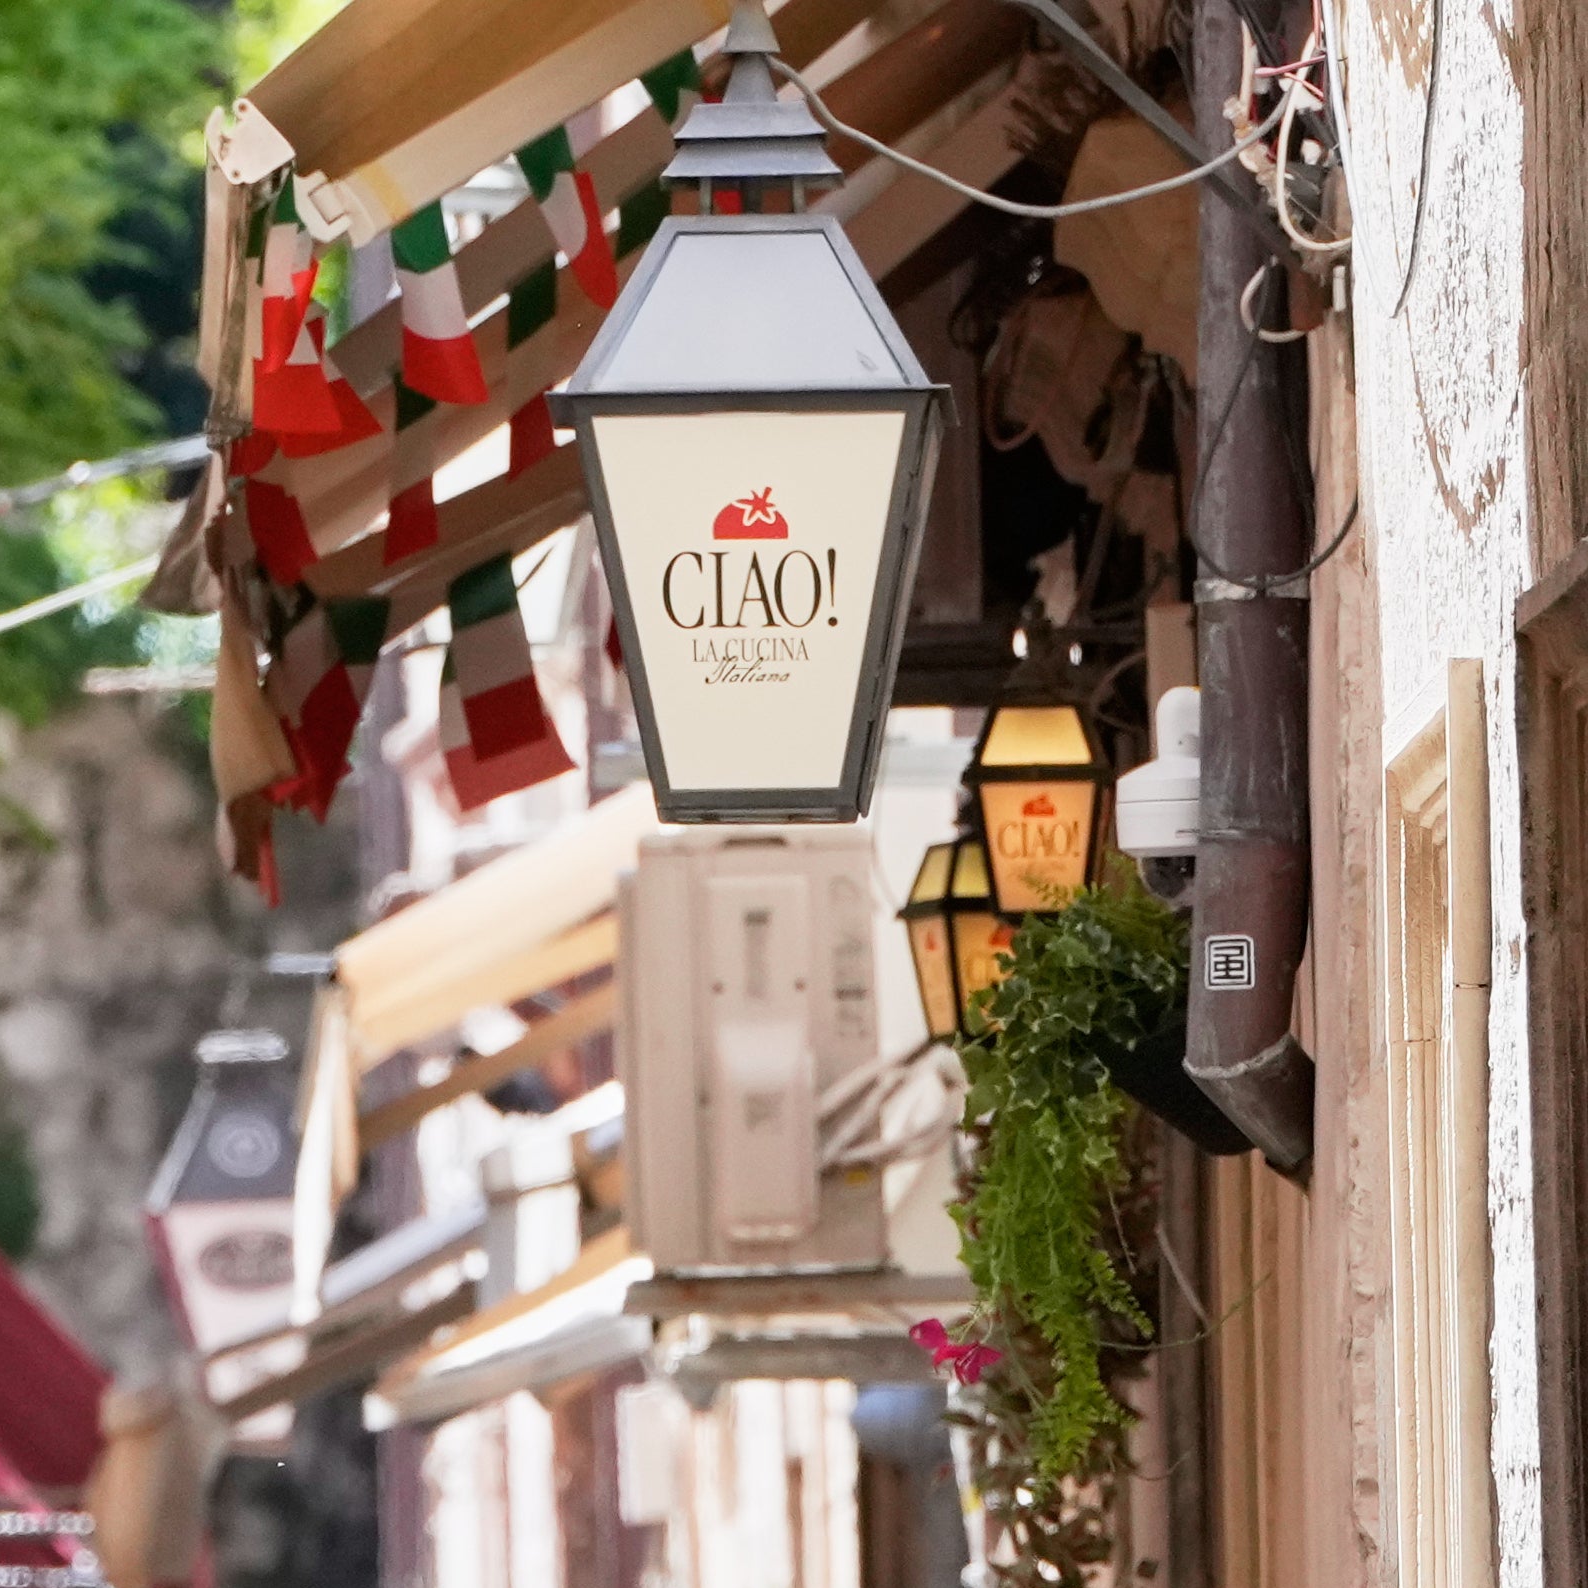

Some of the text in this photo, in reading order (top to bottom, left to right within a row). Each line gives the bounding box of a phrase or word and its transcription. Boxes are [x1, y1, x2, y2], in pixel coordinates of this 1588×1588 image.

[662, 547, 839, 630] CIAO!
[692, 637, 810, 663] LA CUCINA
[704, 655, 791, 684] Italiana
[997, 819, 1080, 859] CIAO!
